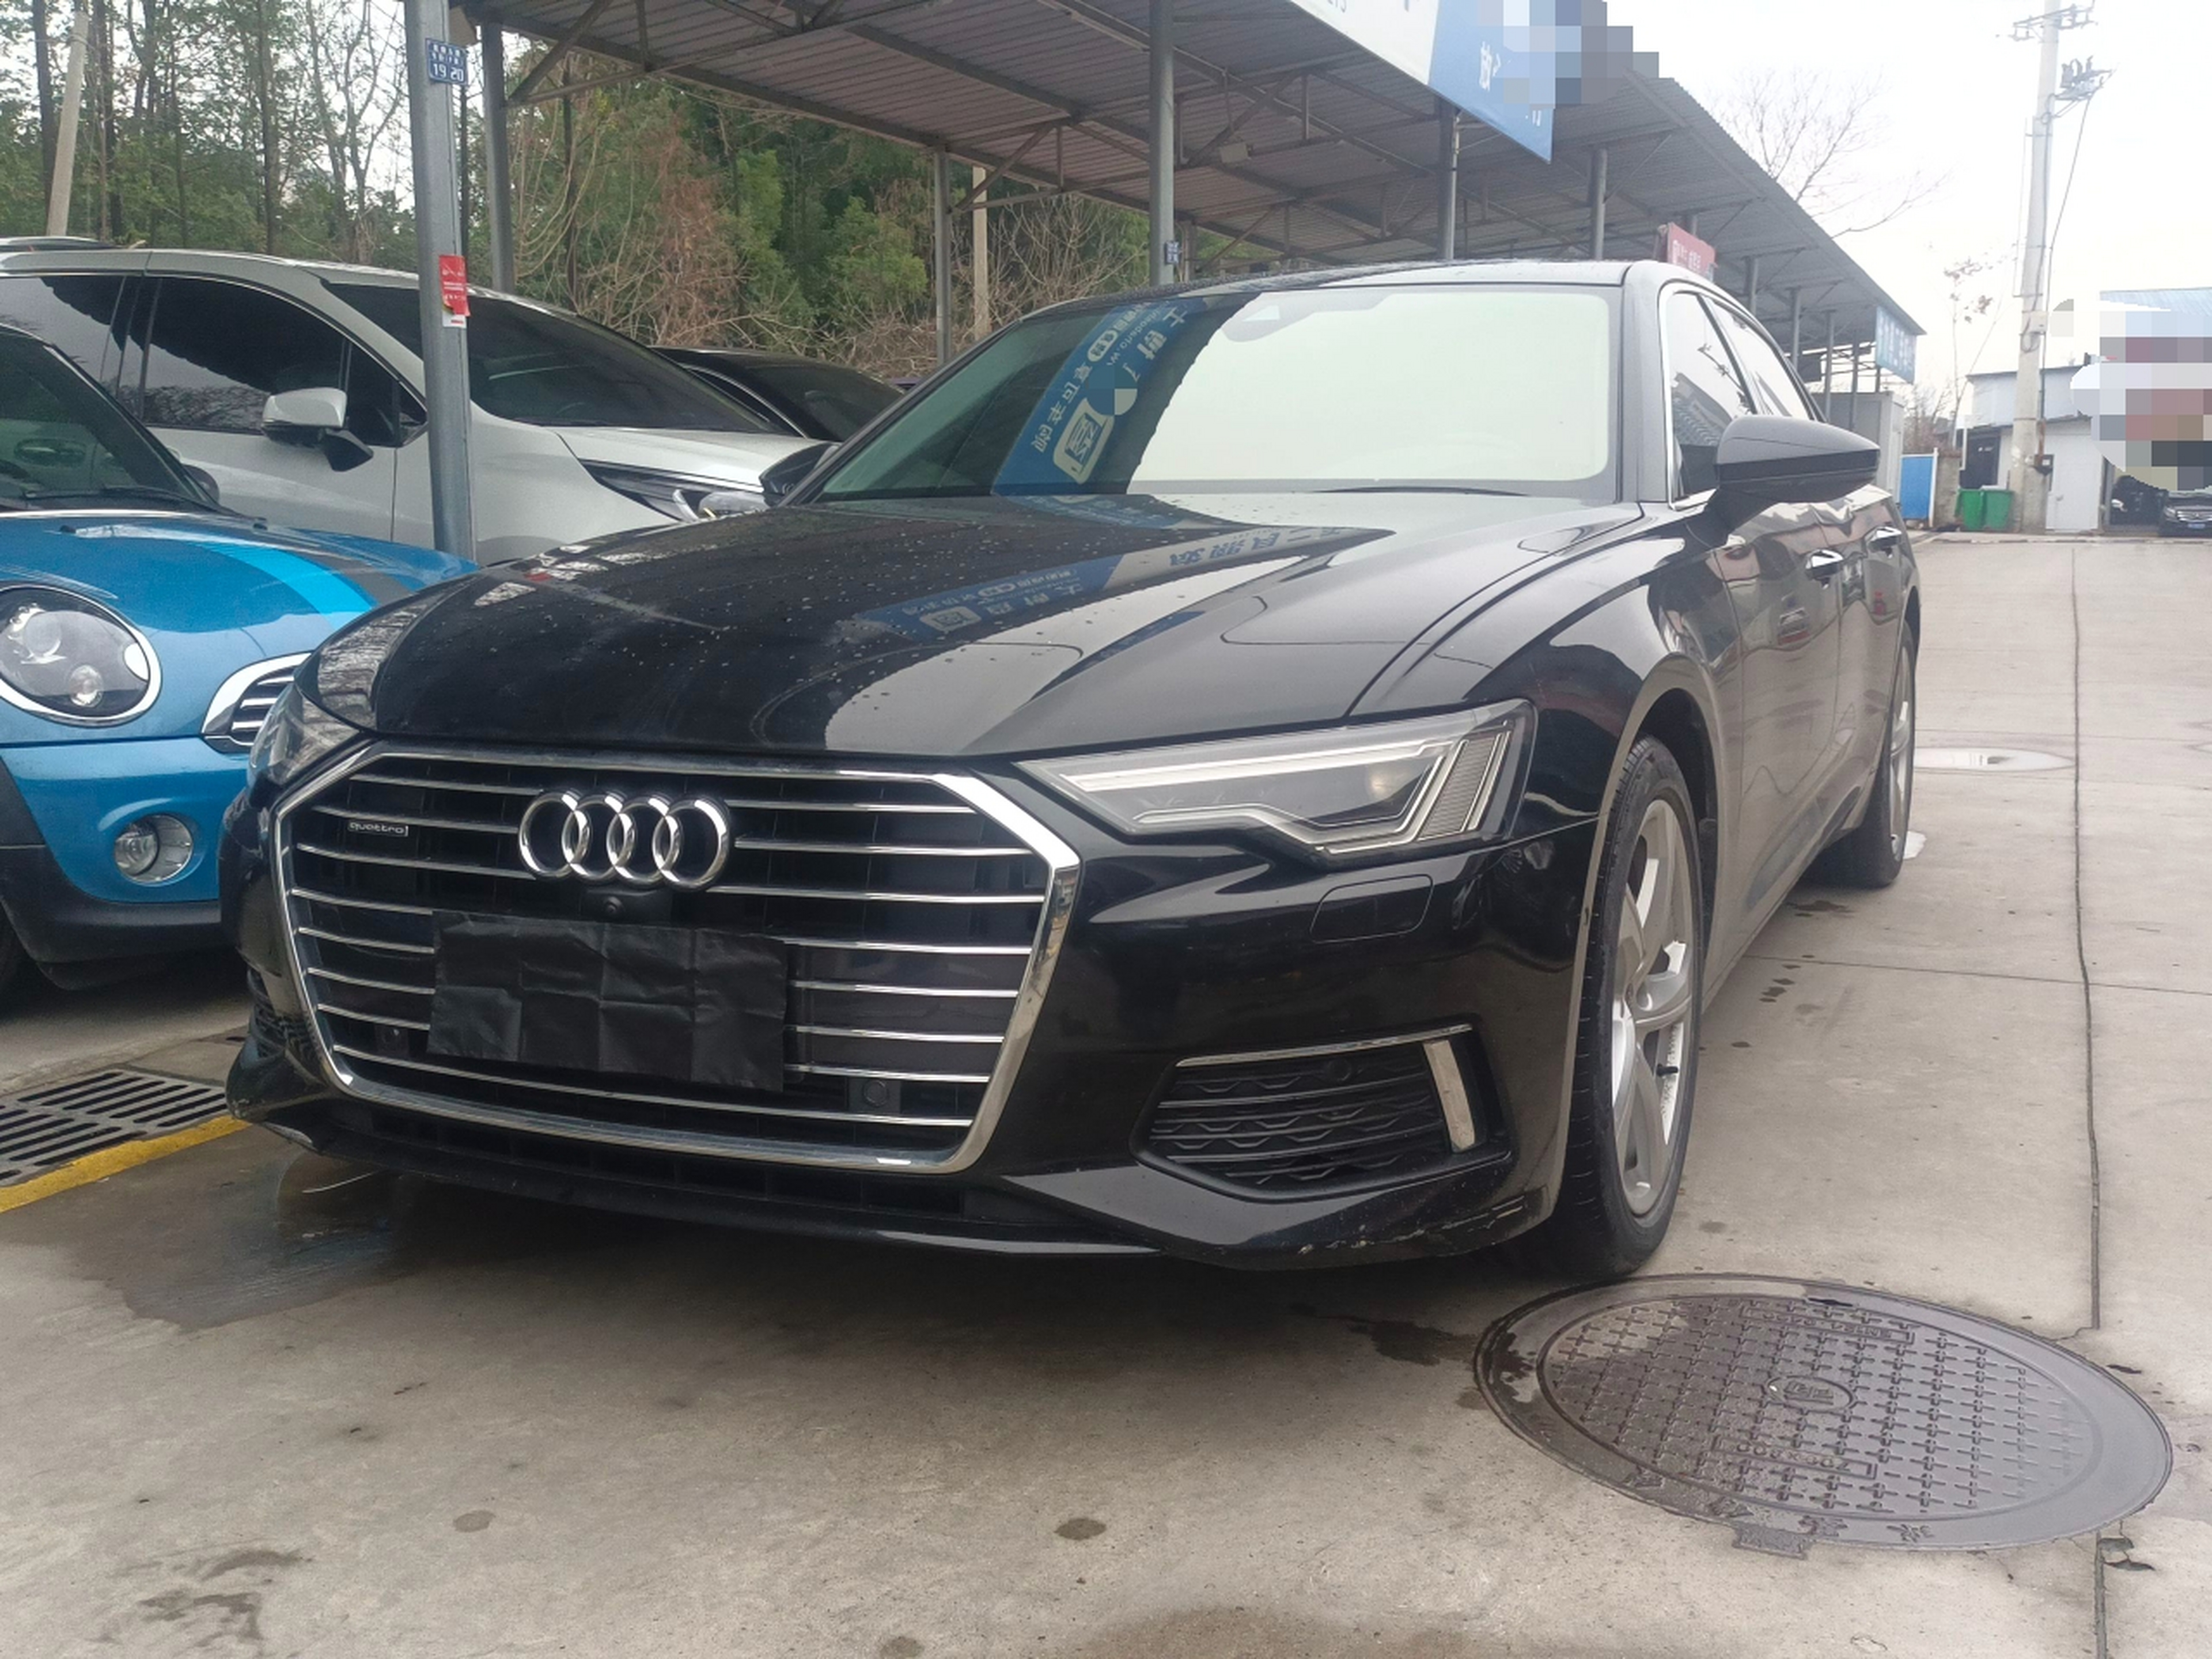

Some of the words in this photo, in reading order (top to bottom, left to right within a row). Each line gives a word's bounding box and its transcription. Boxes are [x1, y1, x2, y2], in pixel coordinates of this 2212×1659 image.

[433, 63, 446, 78] 19
[450, 67, 464, 82] 20
[349, 822, 404, 834] quattro
